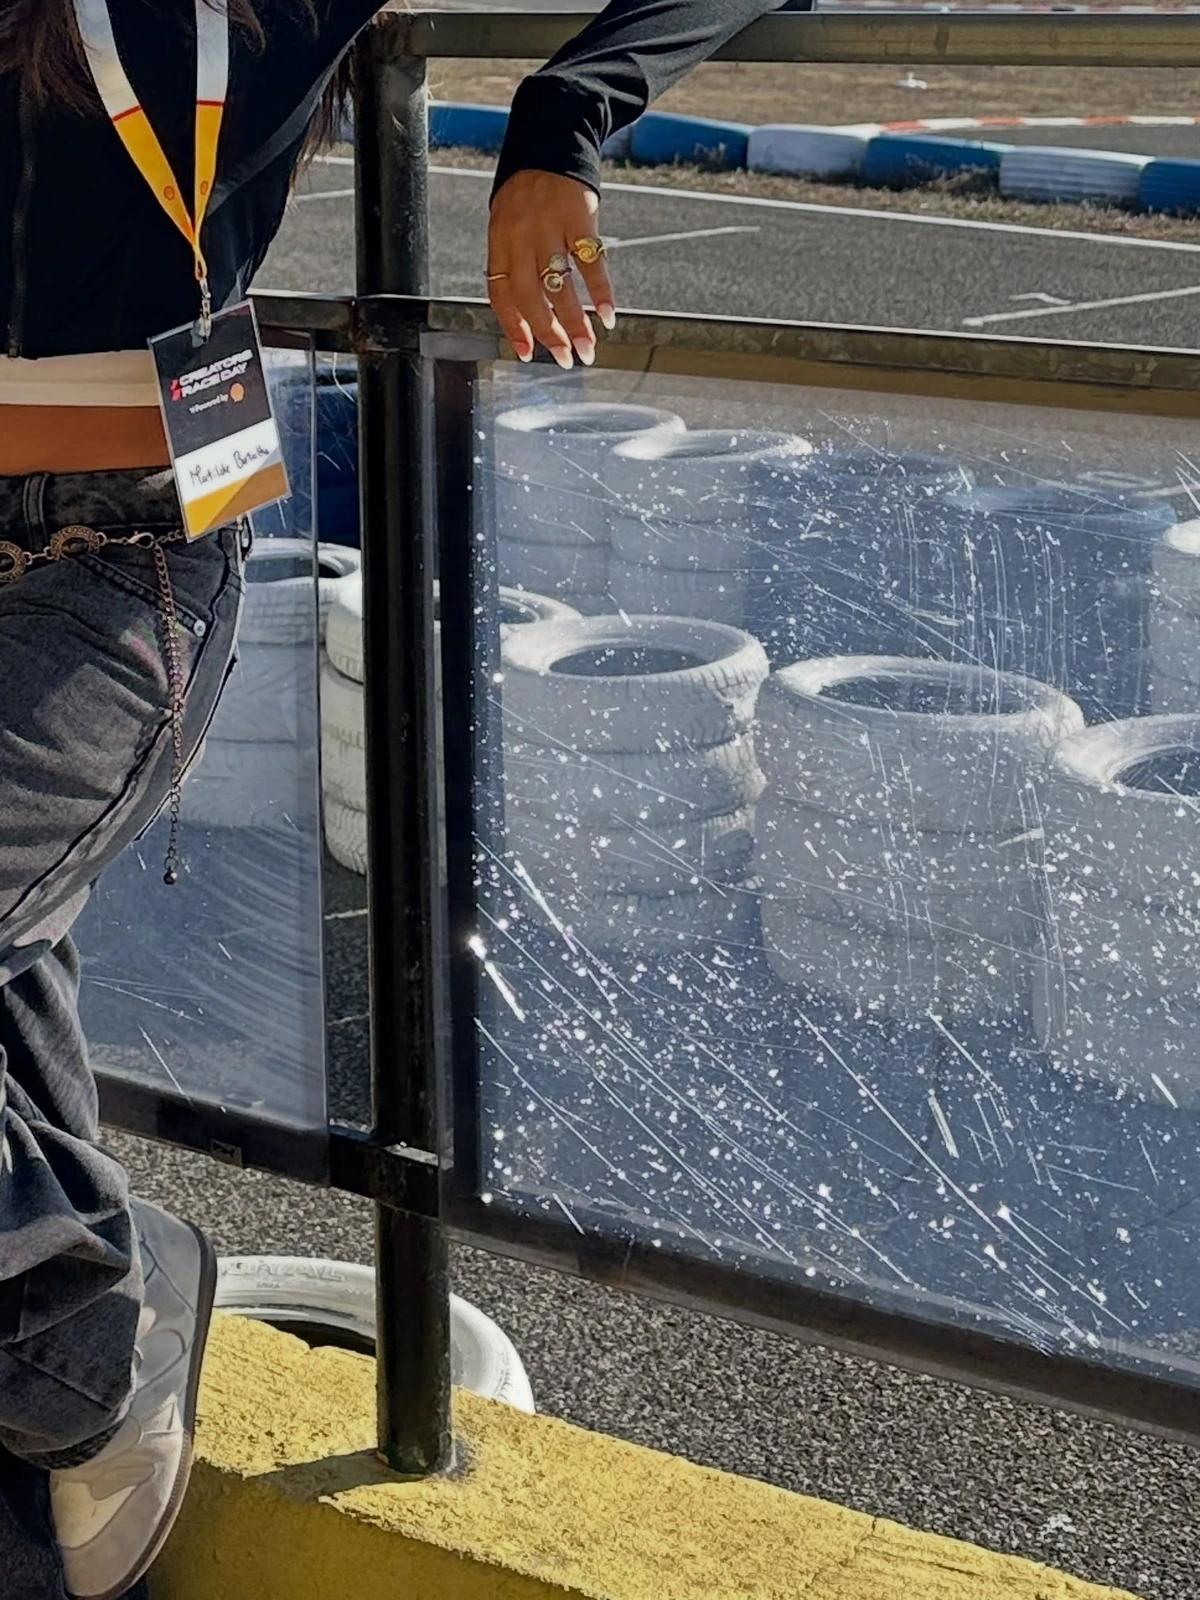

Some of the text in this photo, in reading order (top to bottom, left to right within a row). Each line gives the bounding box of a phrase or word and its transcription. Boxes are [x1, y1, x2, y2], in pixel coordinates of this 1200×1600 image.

[179, 348, 253, 387] CREATORS
[181, 362, 247, 397] RACE DAY
